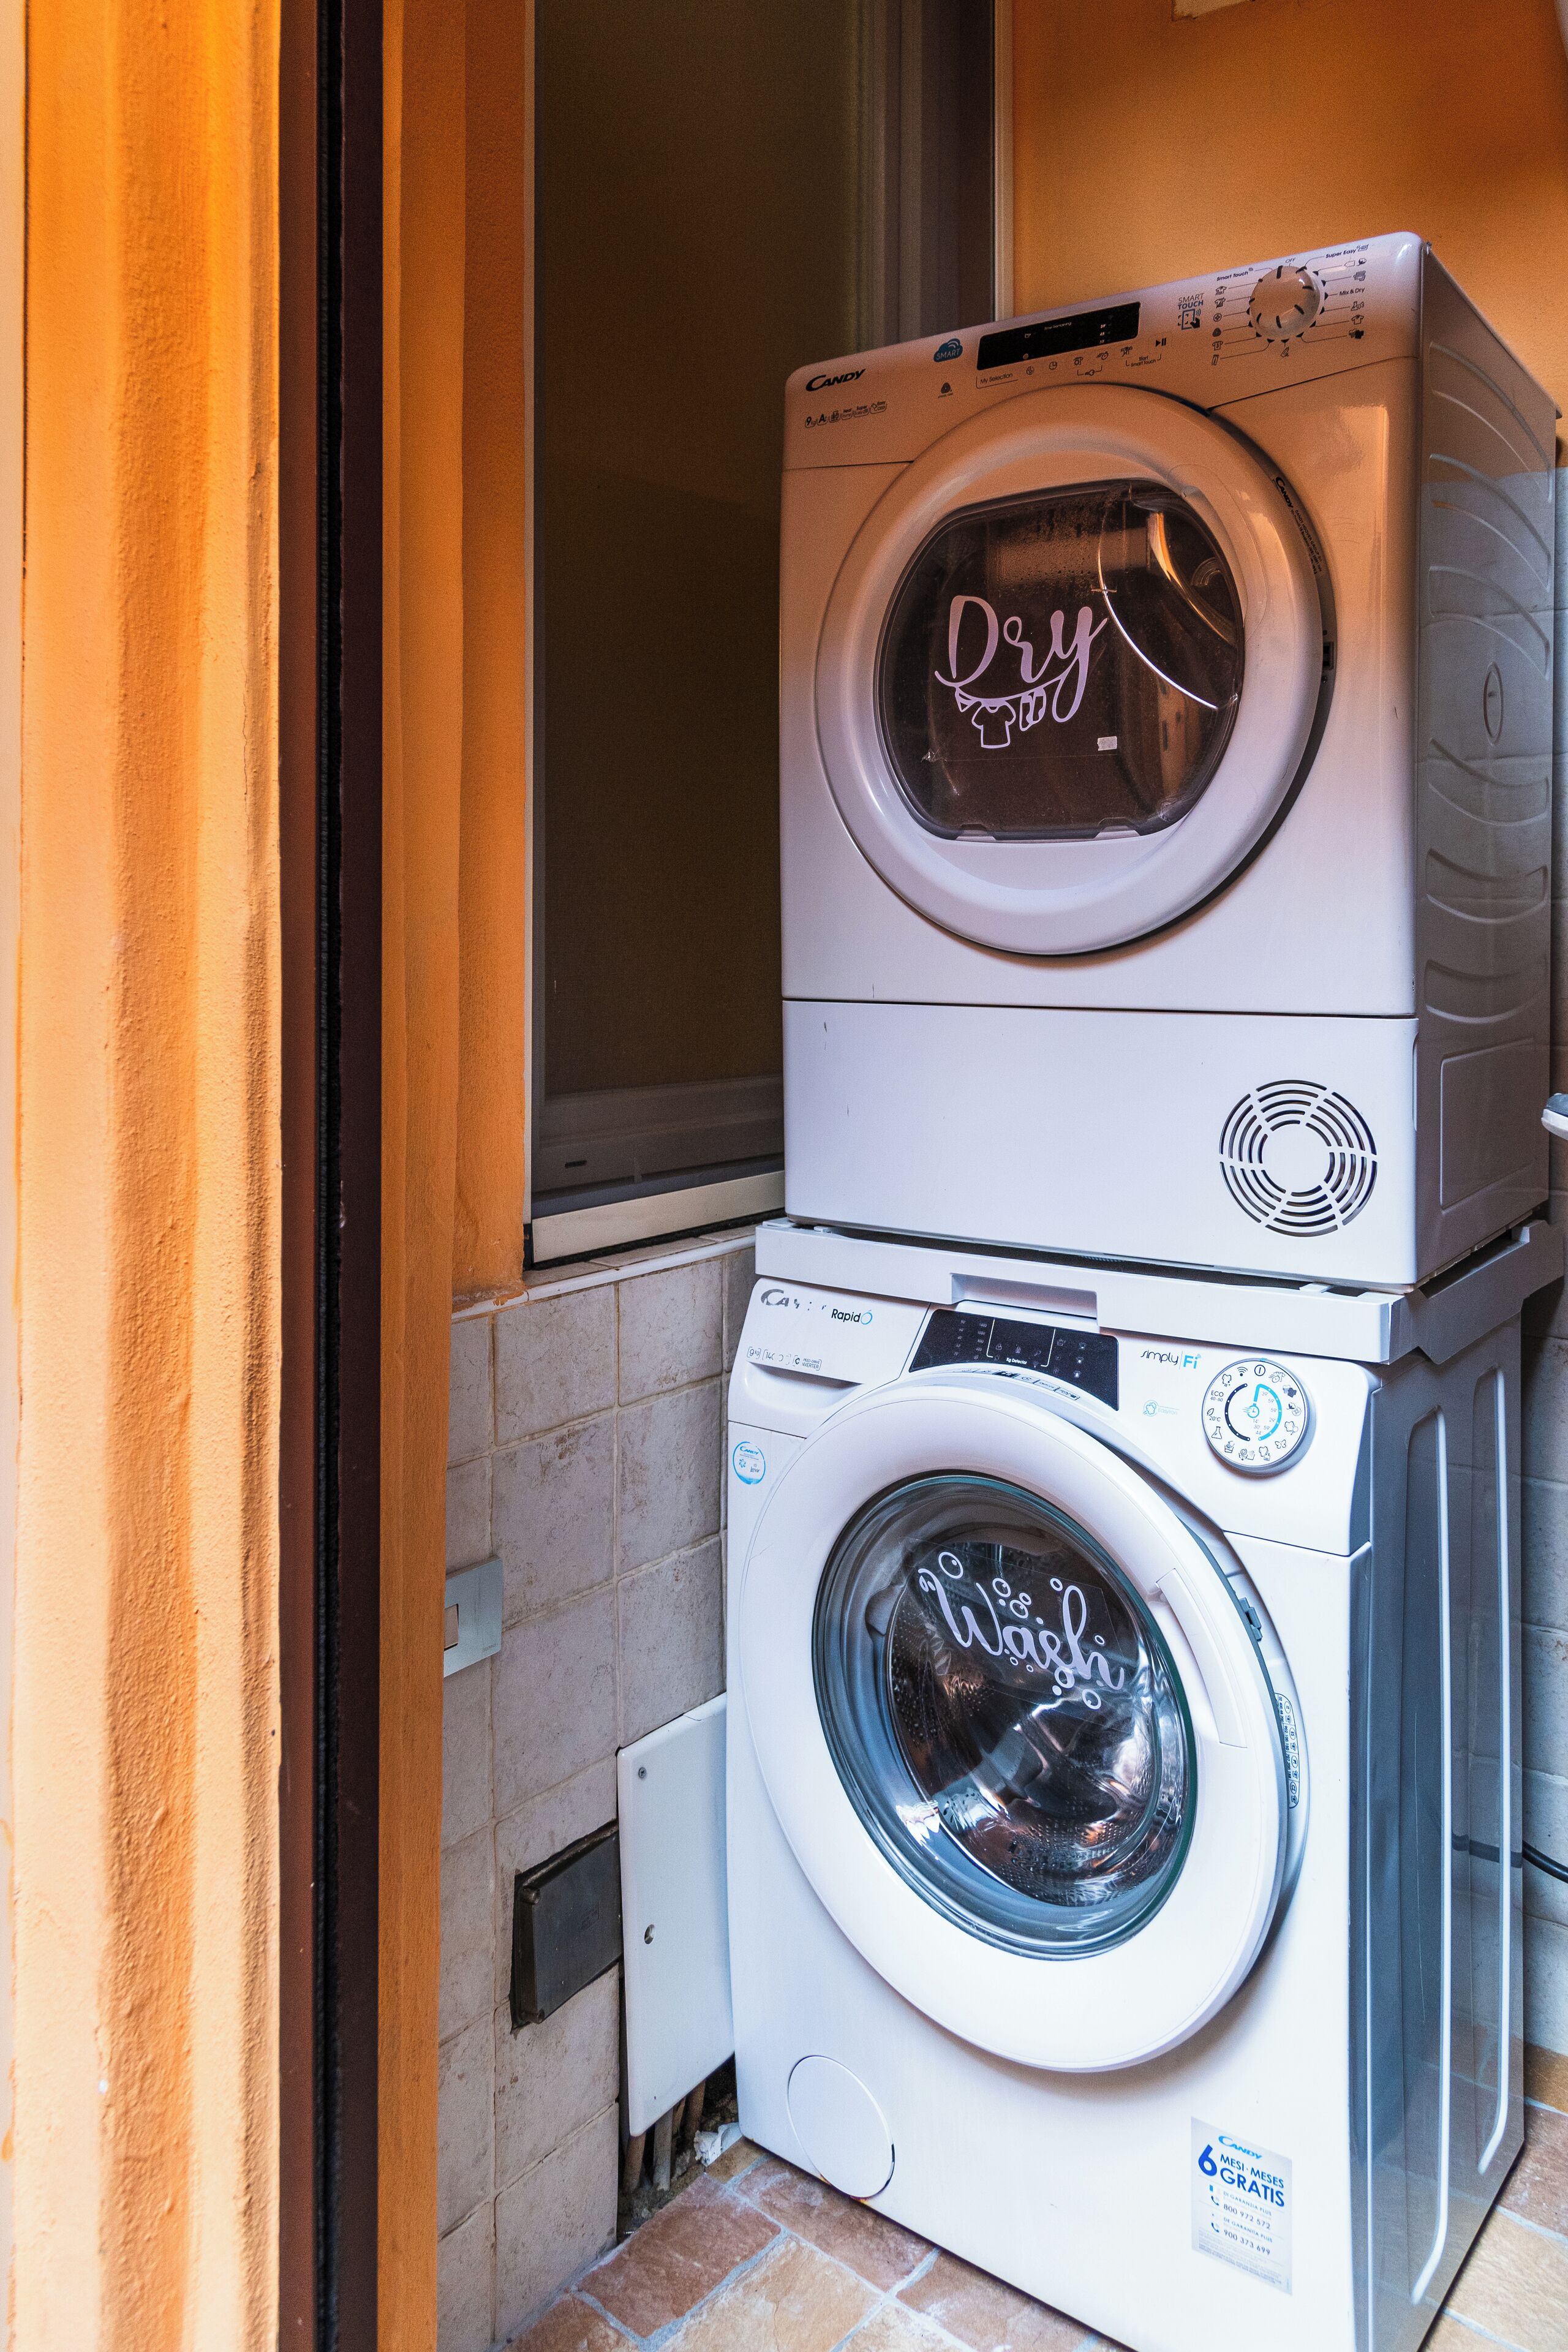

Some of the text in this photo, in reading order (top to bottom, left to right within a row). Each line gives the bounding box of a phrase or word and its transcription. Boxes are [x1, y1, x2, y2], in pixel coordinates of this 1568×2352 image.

[1178, 293, 1204, 304] SMART
[1178, 300, 1204, 310] TOUCH
[937, 348, 960, 360] SMART
[806, 368, 866, 391] CANDY
[989, 372, 1012, 382] Selection
[935, 595, 1109, 723] Dry
[1140, 1349, 1178, 1366] simply
[740, 1446, 758, 1455] CANDY
[918, 1569, 1125, 1690] Wash
[1218, 2135, 1262, 2160] CANDY
[1198, 2144, 1217, 2176] 6
[1221, 2154, 1284, 2188] MESI MESES
[1220, 2168, 1284, 2207] GRATIS
[1223, 2203, 1237, 2215] 800
[1240, 2211, 1254, 2222] 972
[1224, 2229, 1270, 2256] 900 373 699
